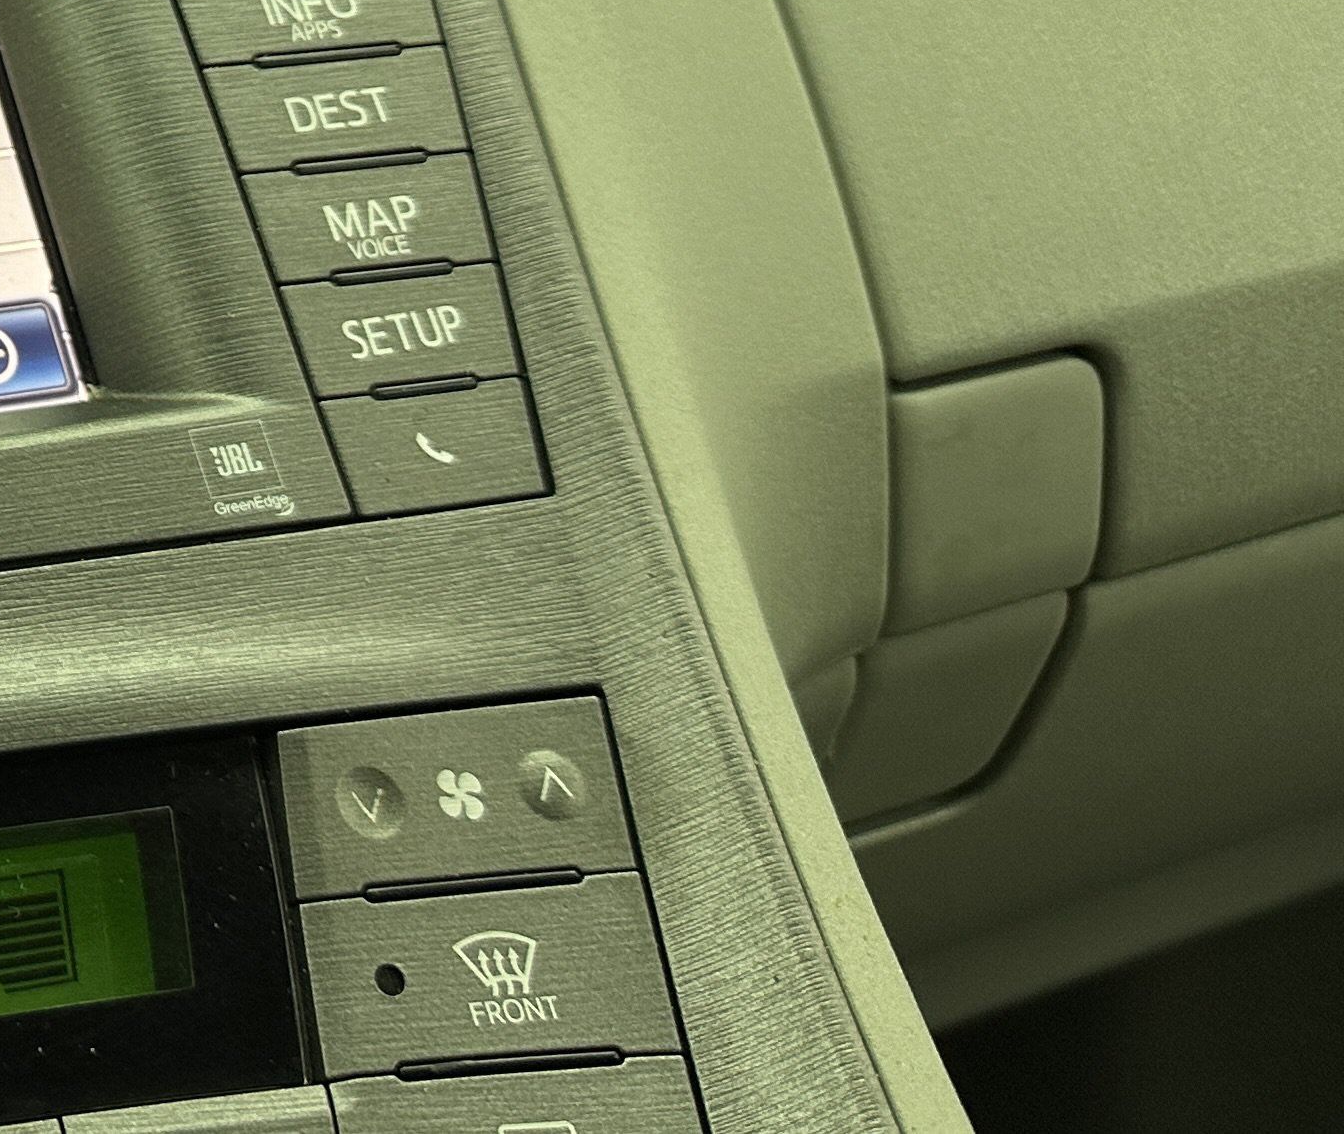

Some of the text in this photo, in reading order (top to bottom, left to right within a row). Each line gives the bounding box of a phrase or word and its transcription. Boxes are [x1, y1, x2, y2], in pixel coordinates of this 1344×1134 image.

[290, 19, 344, 44] APPS
[284, 86, 393, 134] DEST
[322, 194, 417, 243] MAP
[346, 233, 412, 262] VOICE
[341, 304, 464, 360] SETUP
[209, 442, 265, 477] JBL
[213, 494, 291, 516] GreenEdge
[467, 995, 560, 1028] FRONT
